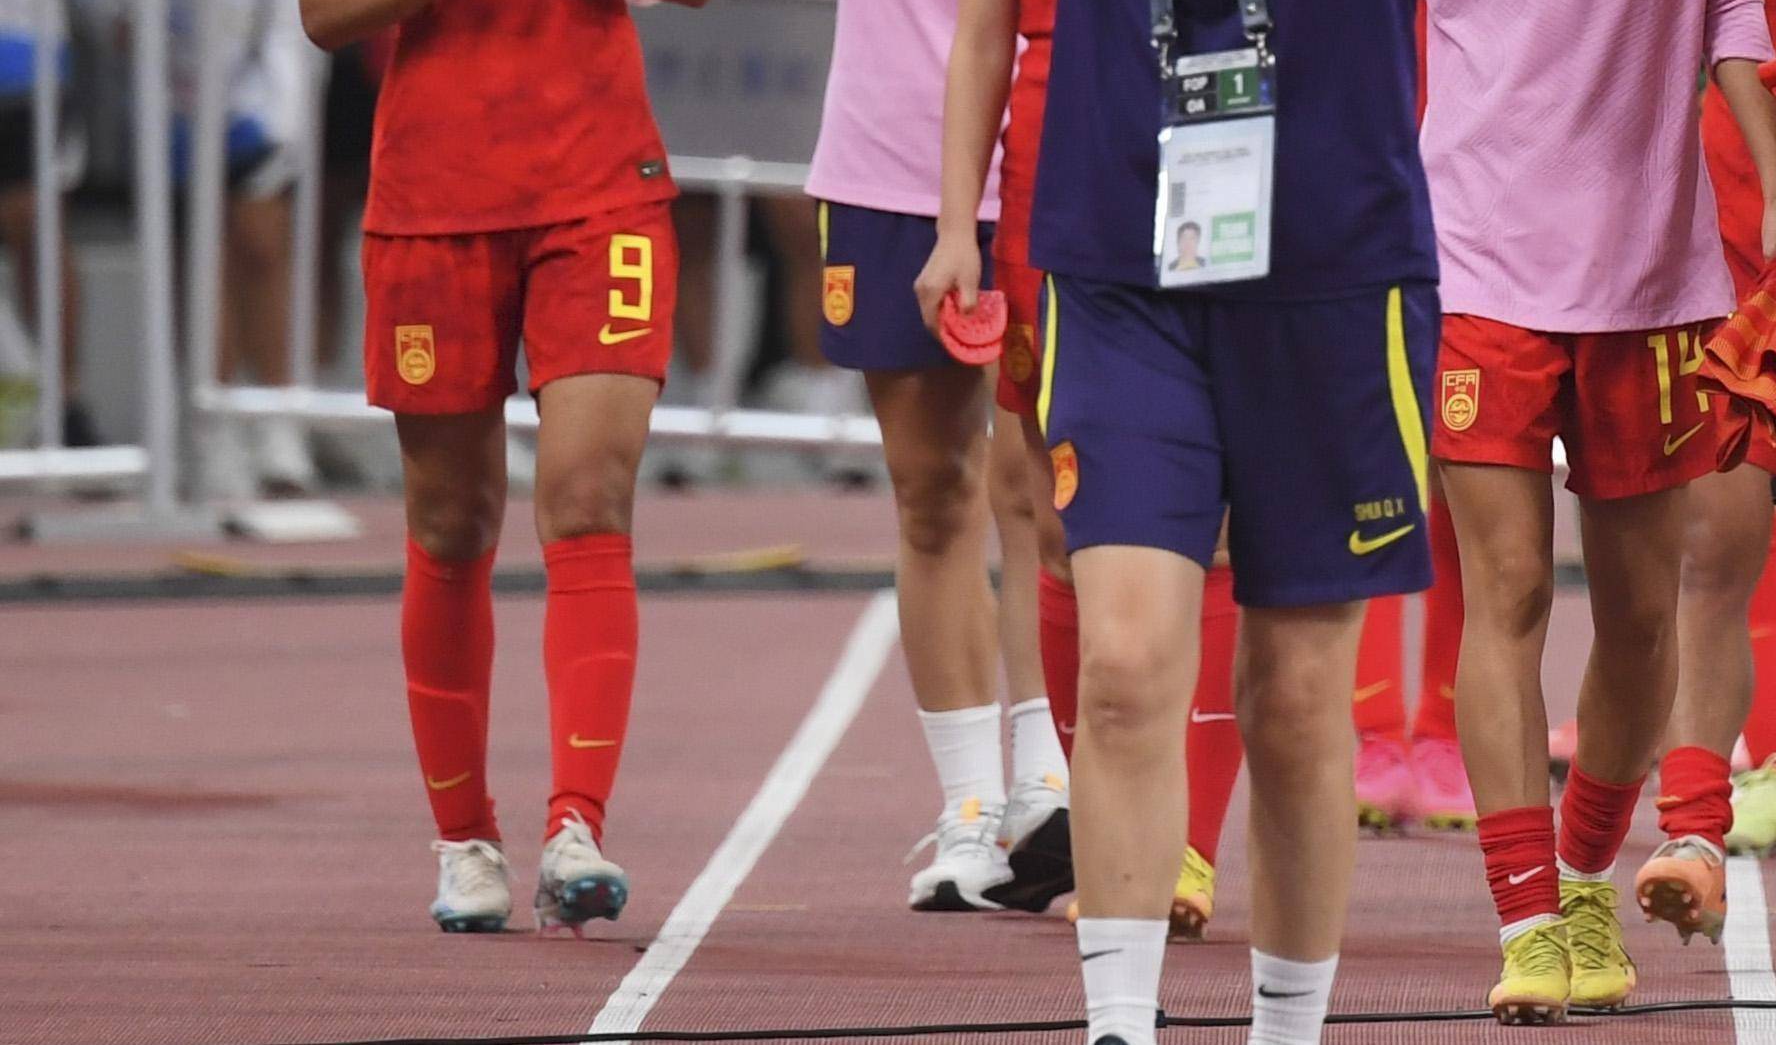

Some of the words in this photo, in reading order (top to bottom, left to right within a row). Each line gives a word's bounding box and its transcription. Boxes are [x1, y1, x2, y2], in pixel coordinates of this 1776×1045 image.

[1233, 73, 1244, 95] 1
[609, 233, 652, 321] 9
[1446, 374, 1476, 386] CFA
[1647, 325, 1710, 424] 14
